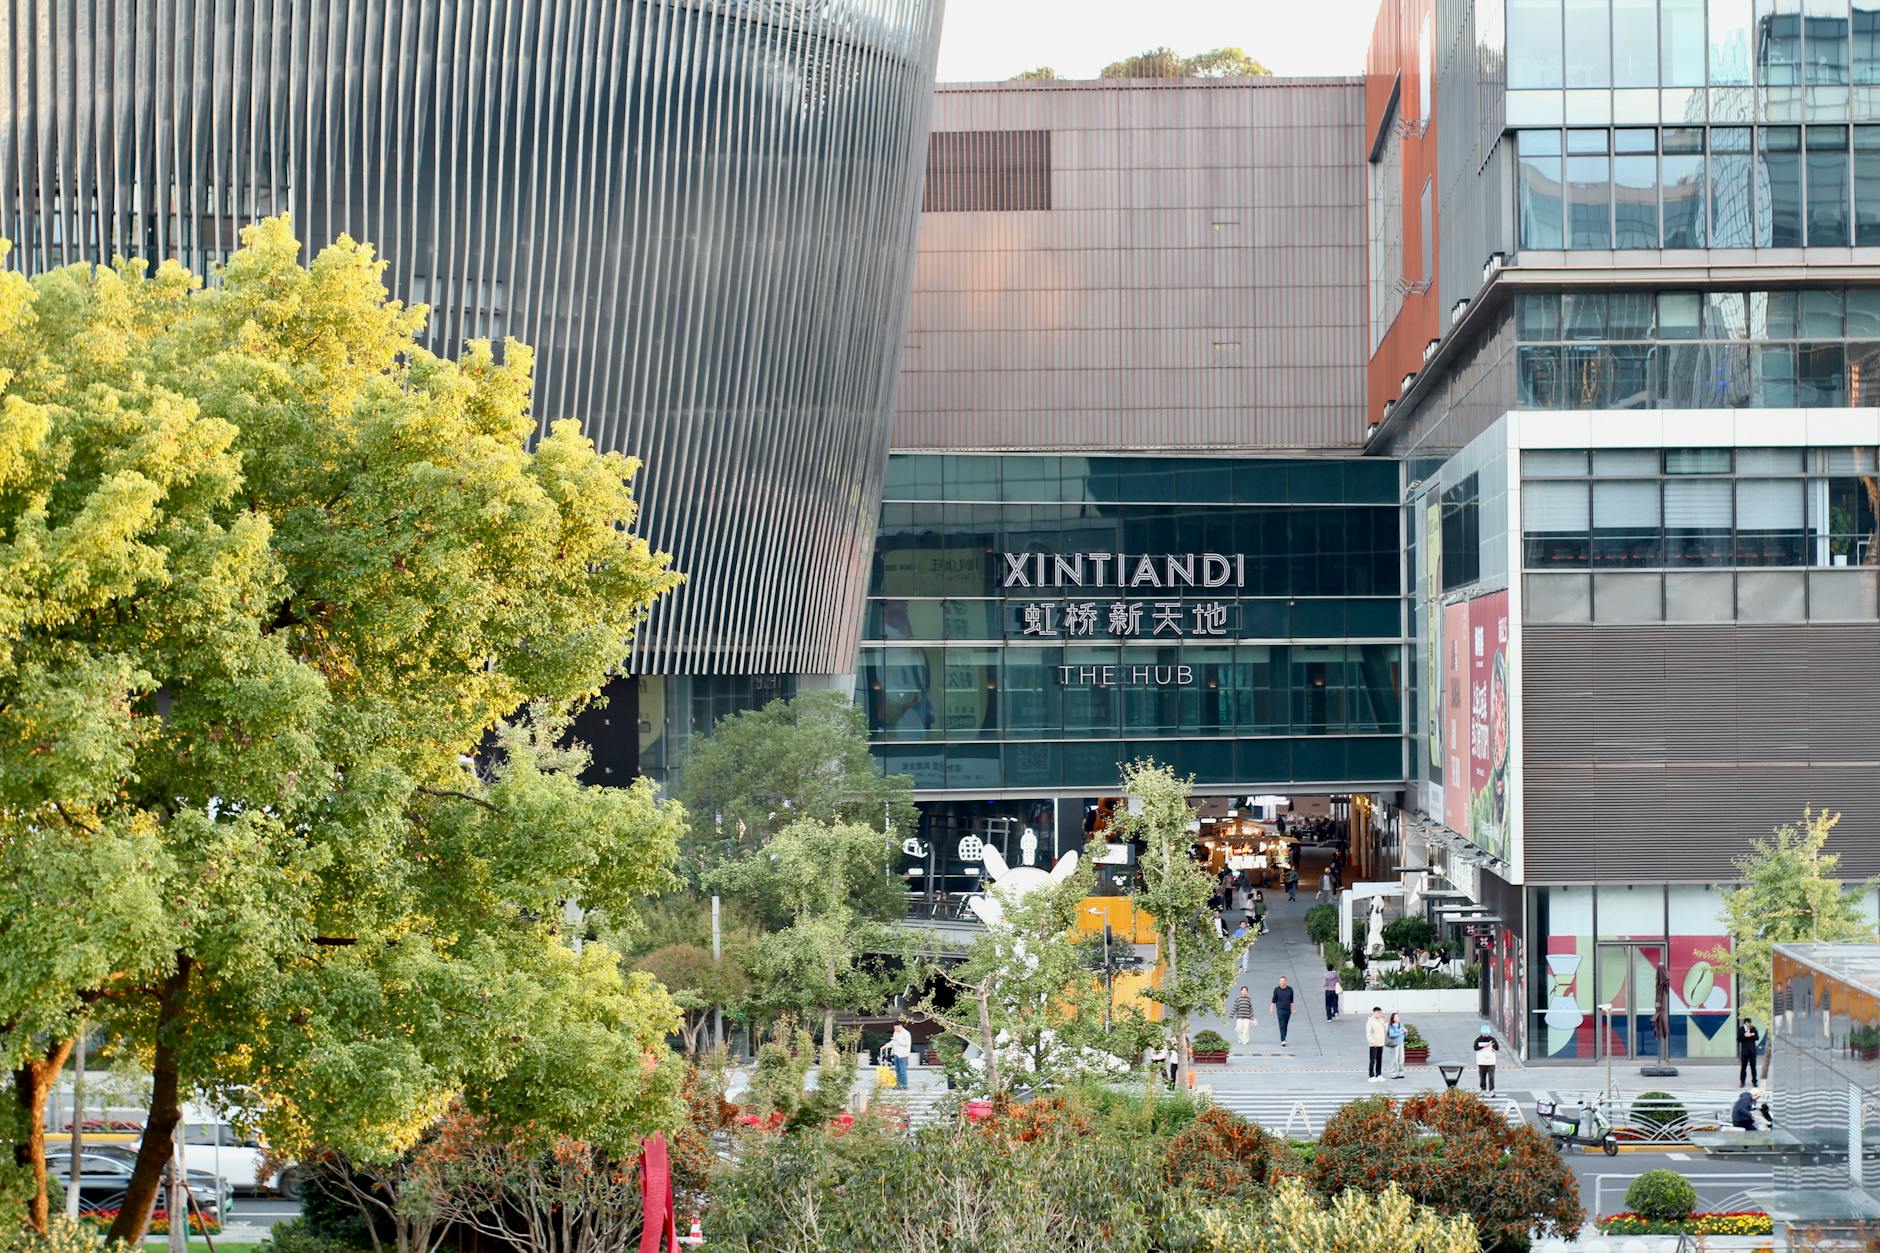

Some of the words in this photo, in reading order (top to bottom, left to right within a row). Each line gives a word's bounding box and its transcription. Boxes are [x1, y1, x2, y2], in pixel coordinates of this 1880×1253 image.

[1004, 552, 1245, 588] XINTIANDI
[1024, 601, 1227, 636] 虹桥新天地
[1059, 665, 1116, 686] THE
[1132, 665, 1193, 686] HUB
